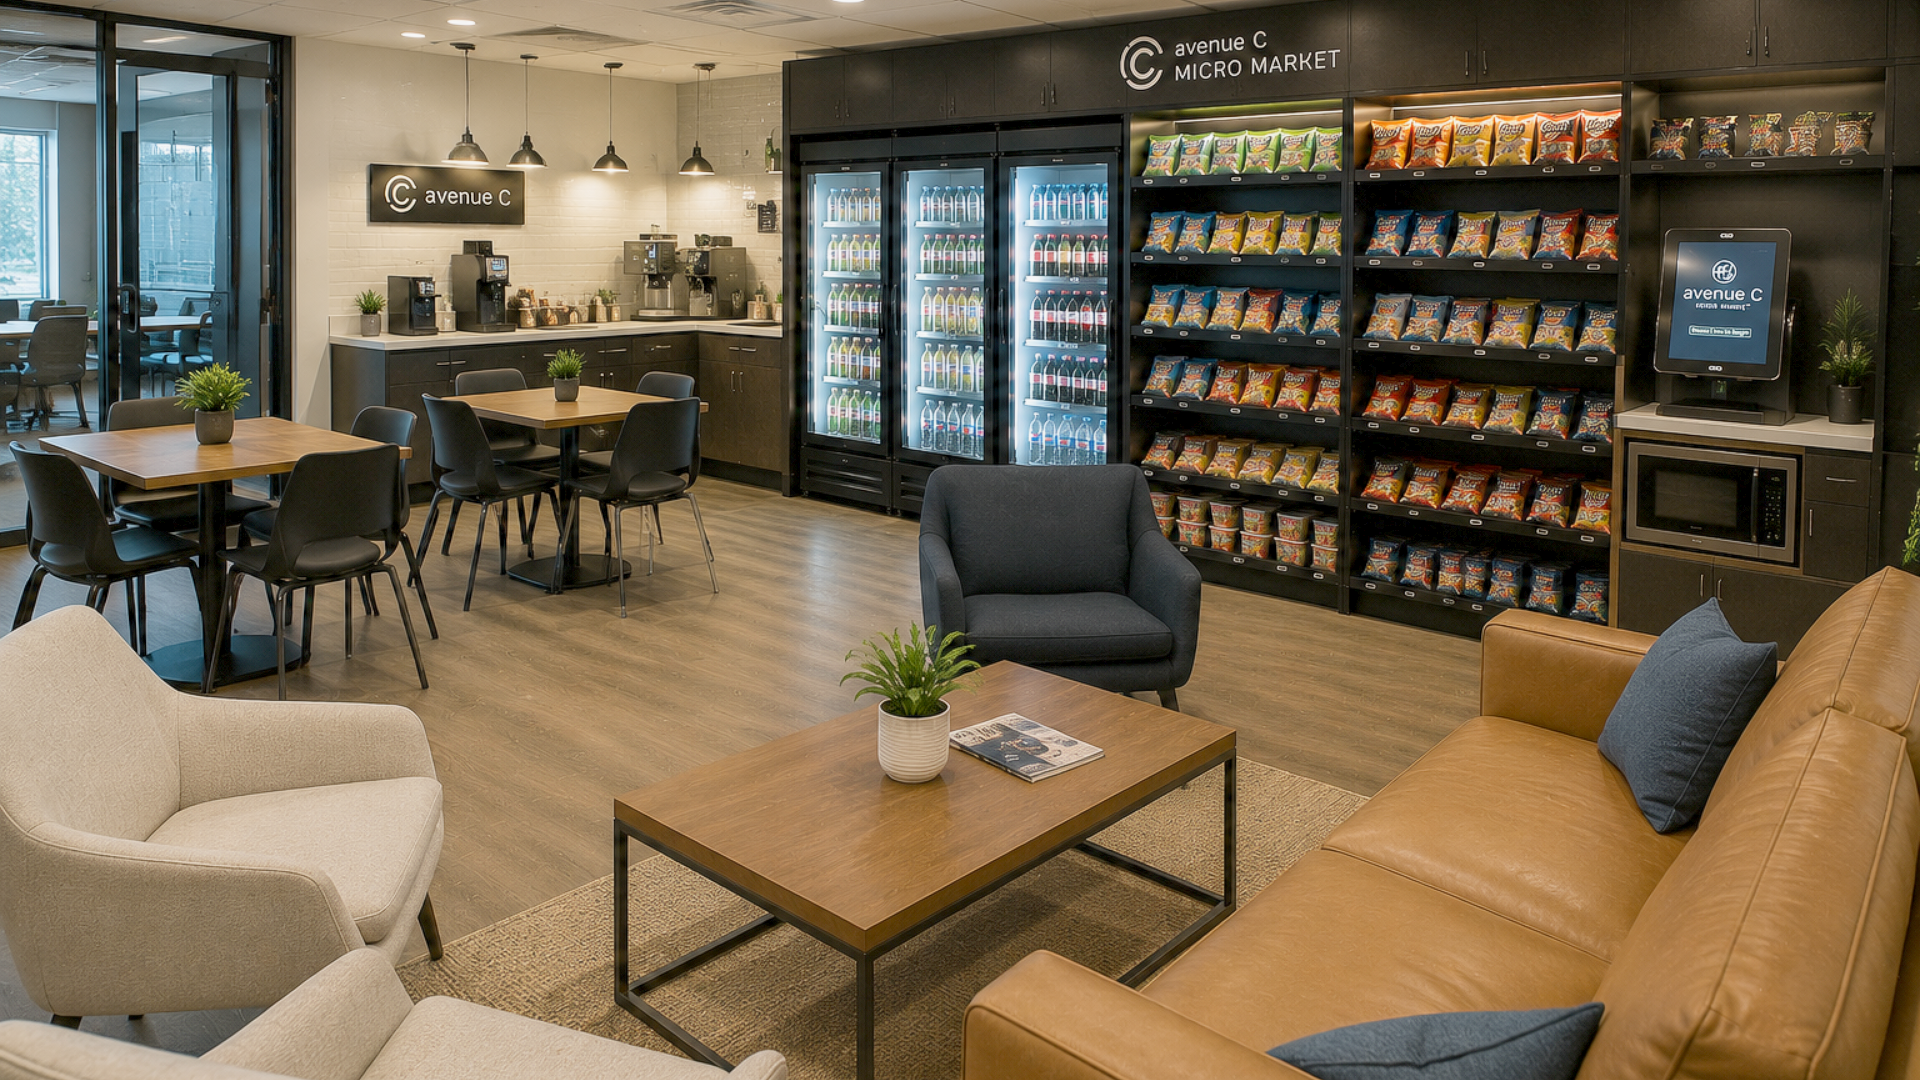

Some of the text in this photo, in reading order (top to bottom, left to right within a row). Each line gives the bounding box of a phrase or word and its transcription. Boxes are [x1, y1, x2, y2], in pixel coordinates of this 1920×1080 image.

[1174, 30, 1268, 57] avenue C
[1174, 49, 1341, 81] MICRO MARKET
[425, 189, 511, 207] avenue C
[1682, 287, 1764, 302] avenue C
